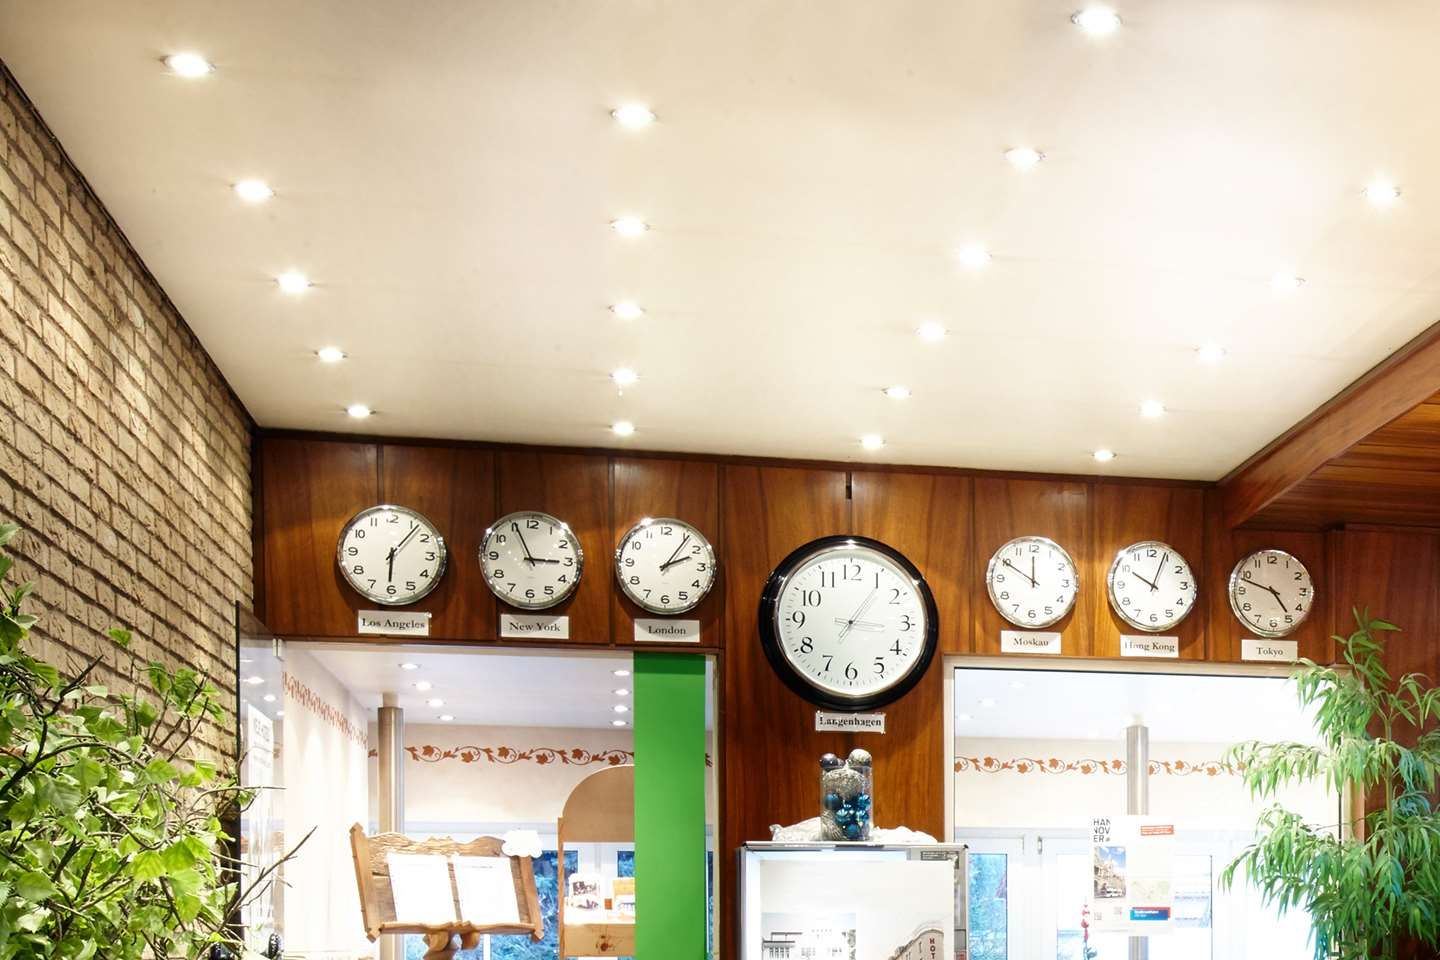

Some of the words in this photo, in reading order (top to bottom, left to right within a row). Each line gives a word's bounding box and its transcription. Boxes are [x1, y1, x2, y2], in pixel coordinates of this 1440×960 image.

[526, 520, 539, 530] 12
[355, 529, 366, 539] 10
[660, 526, 672, 536] 12
[420, 534, 430, 543] 2
[495, 534, 507, 543] 10
[558, 540, 568, 549] 2
[631, 541, 642, 550] 10
[691, 545, 701, 554] 2
[347, 546, 358, 556] 9
[425, 551, 435, 561] 3
[489, 551, 499, 560] 9
[563, 557, 574, 567] 3
[625, 558, 635, 567] 9
[353, 565, 364, 575] 8
[696, 563, 706, 572] 3
[843, 564, 862, 581] 12
[420, 569, 429, 578] 4
[493, 569, 504, 579] 8
[367, 579, 377, 589] 7
[557, 574, 567, 584] 4
[629, 575, 640, 585] 8
[691, 579, 700, 588] 4
[821, 571, 835, 588] 11
[875, 572, 879, 589] 1
[386, 585, 397, 595] 6
[405, 581, 416, 591] 5
[507, 583, 516, 592] 7
[544, 585, 554, 595] 5
[525, 589, 535, 599] 6
[643, 589, 652, 599] 7
[678, 591, 688, 600] 5
[802, 589, 822, 607] 10
[888, 588, 901, 605] 2
[660, 595, 670, 605] 6
[362, 618, 381, 626] Los
[384, 618, 425, 630] Angeles
[792, 610, 806, 630] 9
[900, 614, 911, 632] 3
[509, 622, 534, 632] New
[536, 622, 561, 632] York
[648, 626, 686, 635] London
[800, 636, 814, 654] 8
[1014, 638, 1048, 646] Moskau
[1124, 641, 1150, 650] Hong
[1152, 643, 1175, 652] Kong
[890, 639, 902, 656] 4
[1256, 647, 1284, 656] Tokyo
[822, 655, 834, 672] 7
[873, 656, 885, 674] 5
[844, 662, 858, 680] 6
